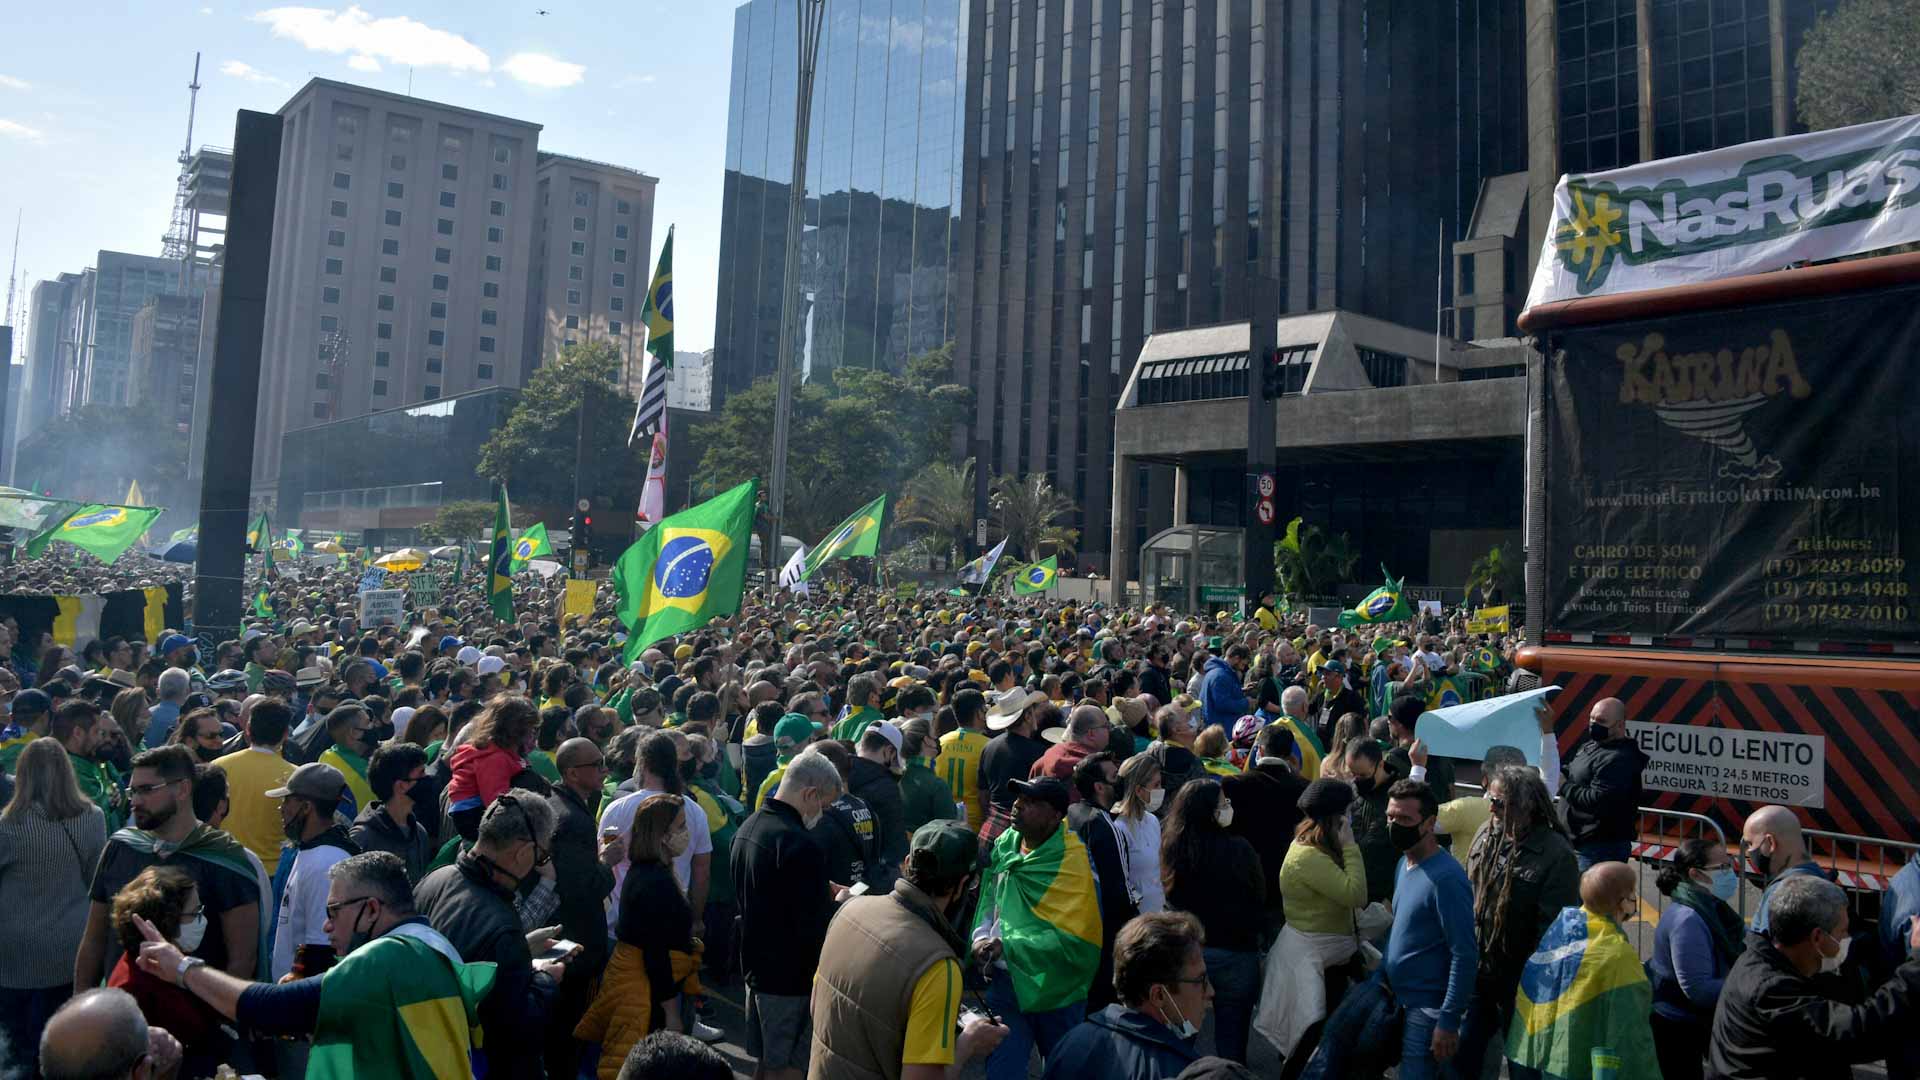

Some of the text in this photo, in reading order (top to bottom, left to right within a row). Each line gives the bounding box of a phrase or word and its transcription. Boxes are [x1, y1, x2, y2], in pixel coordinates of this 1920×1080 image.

[1616, 329, 1812, 404] KATRINA
[1261, 479, 1272, 490] 50
[1574, 544, 1697, 560] CARRO DE SOM
[1568, 566, 1577, 579] E
[1582, 566, 1619, 579] TRIO
[1732, 738, 1813, 766] LENTO
[1644, 774, 1706, 791] LARGURA
[1733, 783, 1789, 800] METROS
[1752, 770, 1810, 787] METROS
